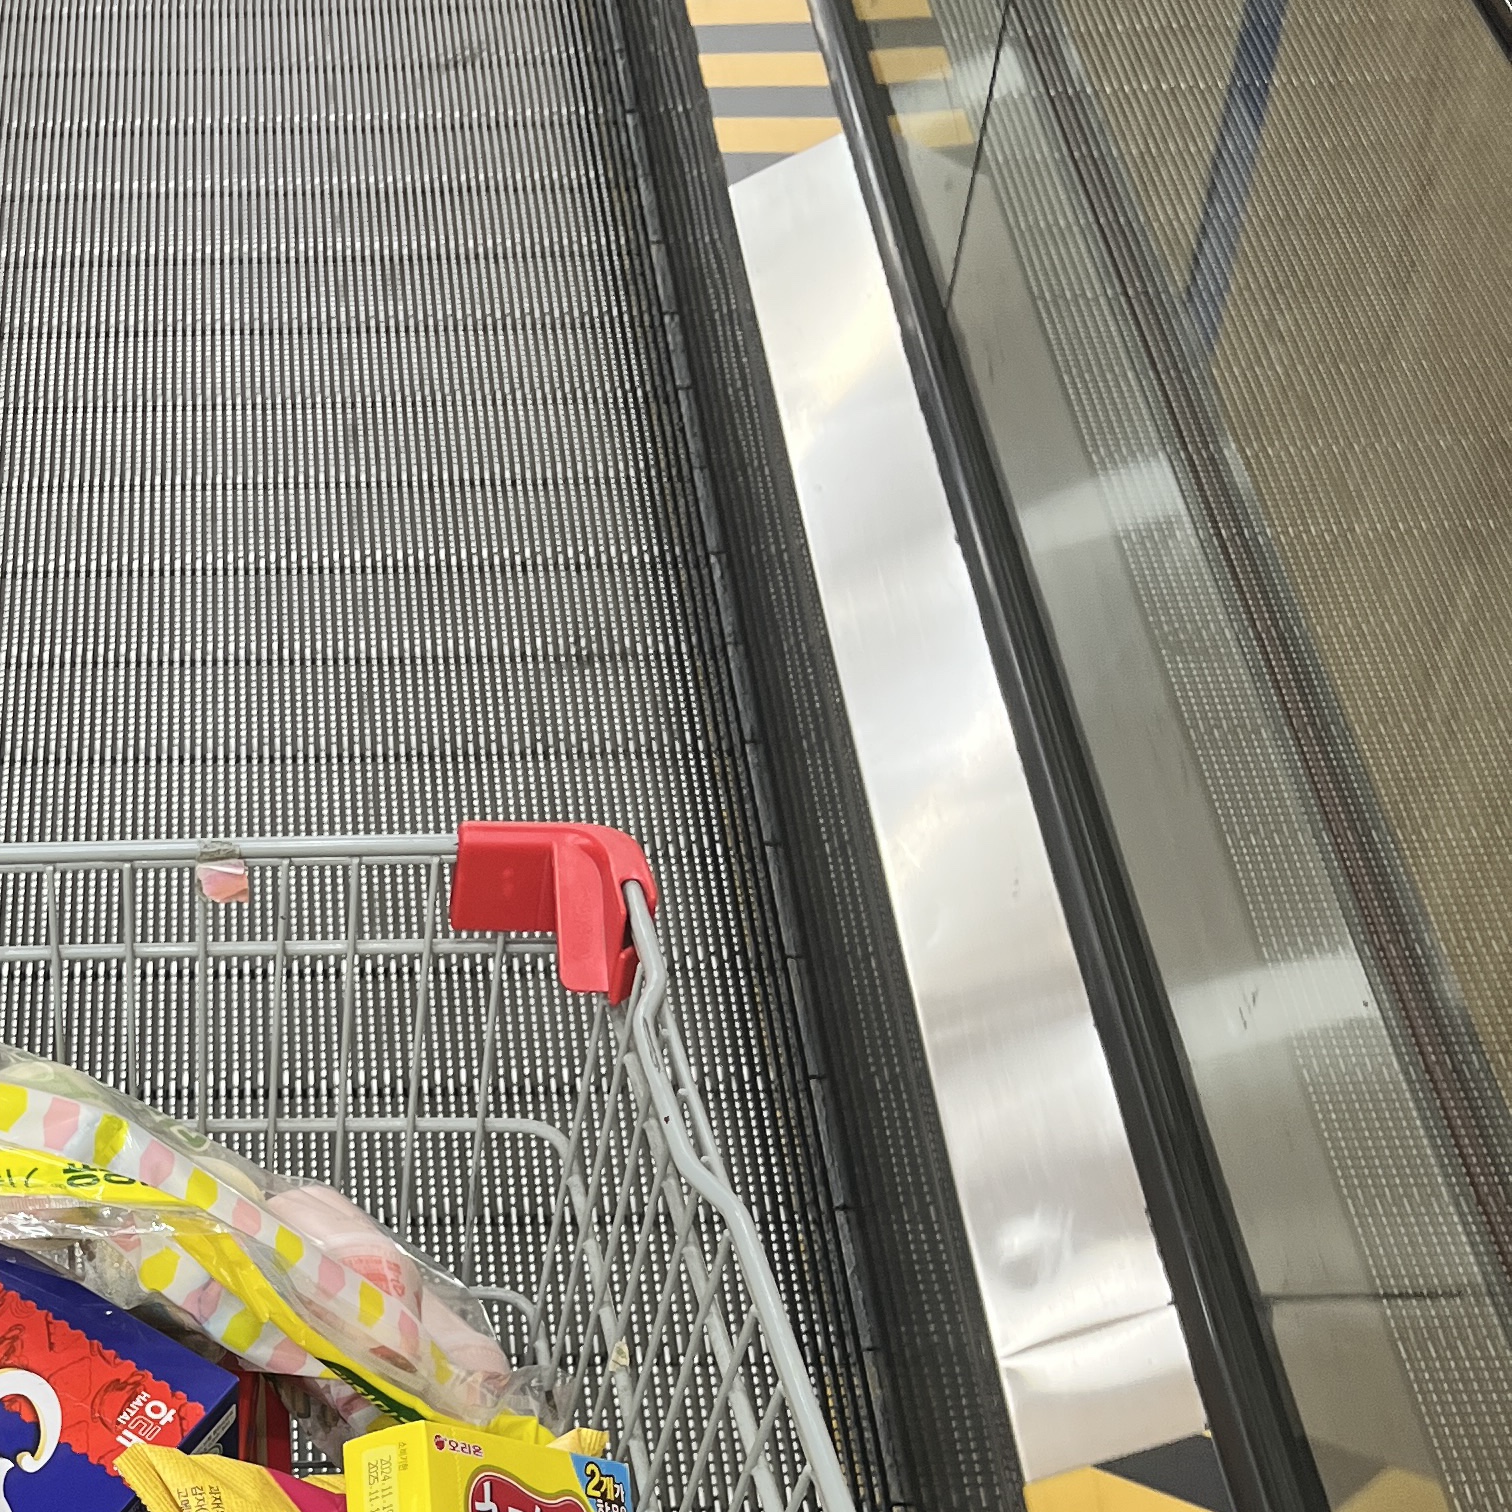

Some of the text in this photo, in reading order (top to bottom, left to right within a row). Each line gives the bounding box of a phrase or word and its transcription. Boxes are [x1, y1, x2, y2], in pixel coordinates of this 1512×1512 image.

[117, 1387, 149, 1427] HAITAI
[448, 1437, 485, 1458] 오리온
[585, 1462, 626, 1503] 2개가
